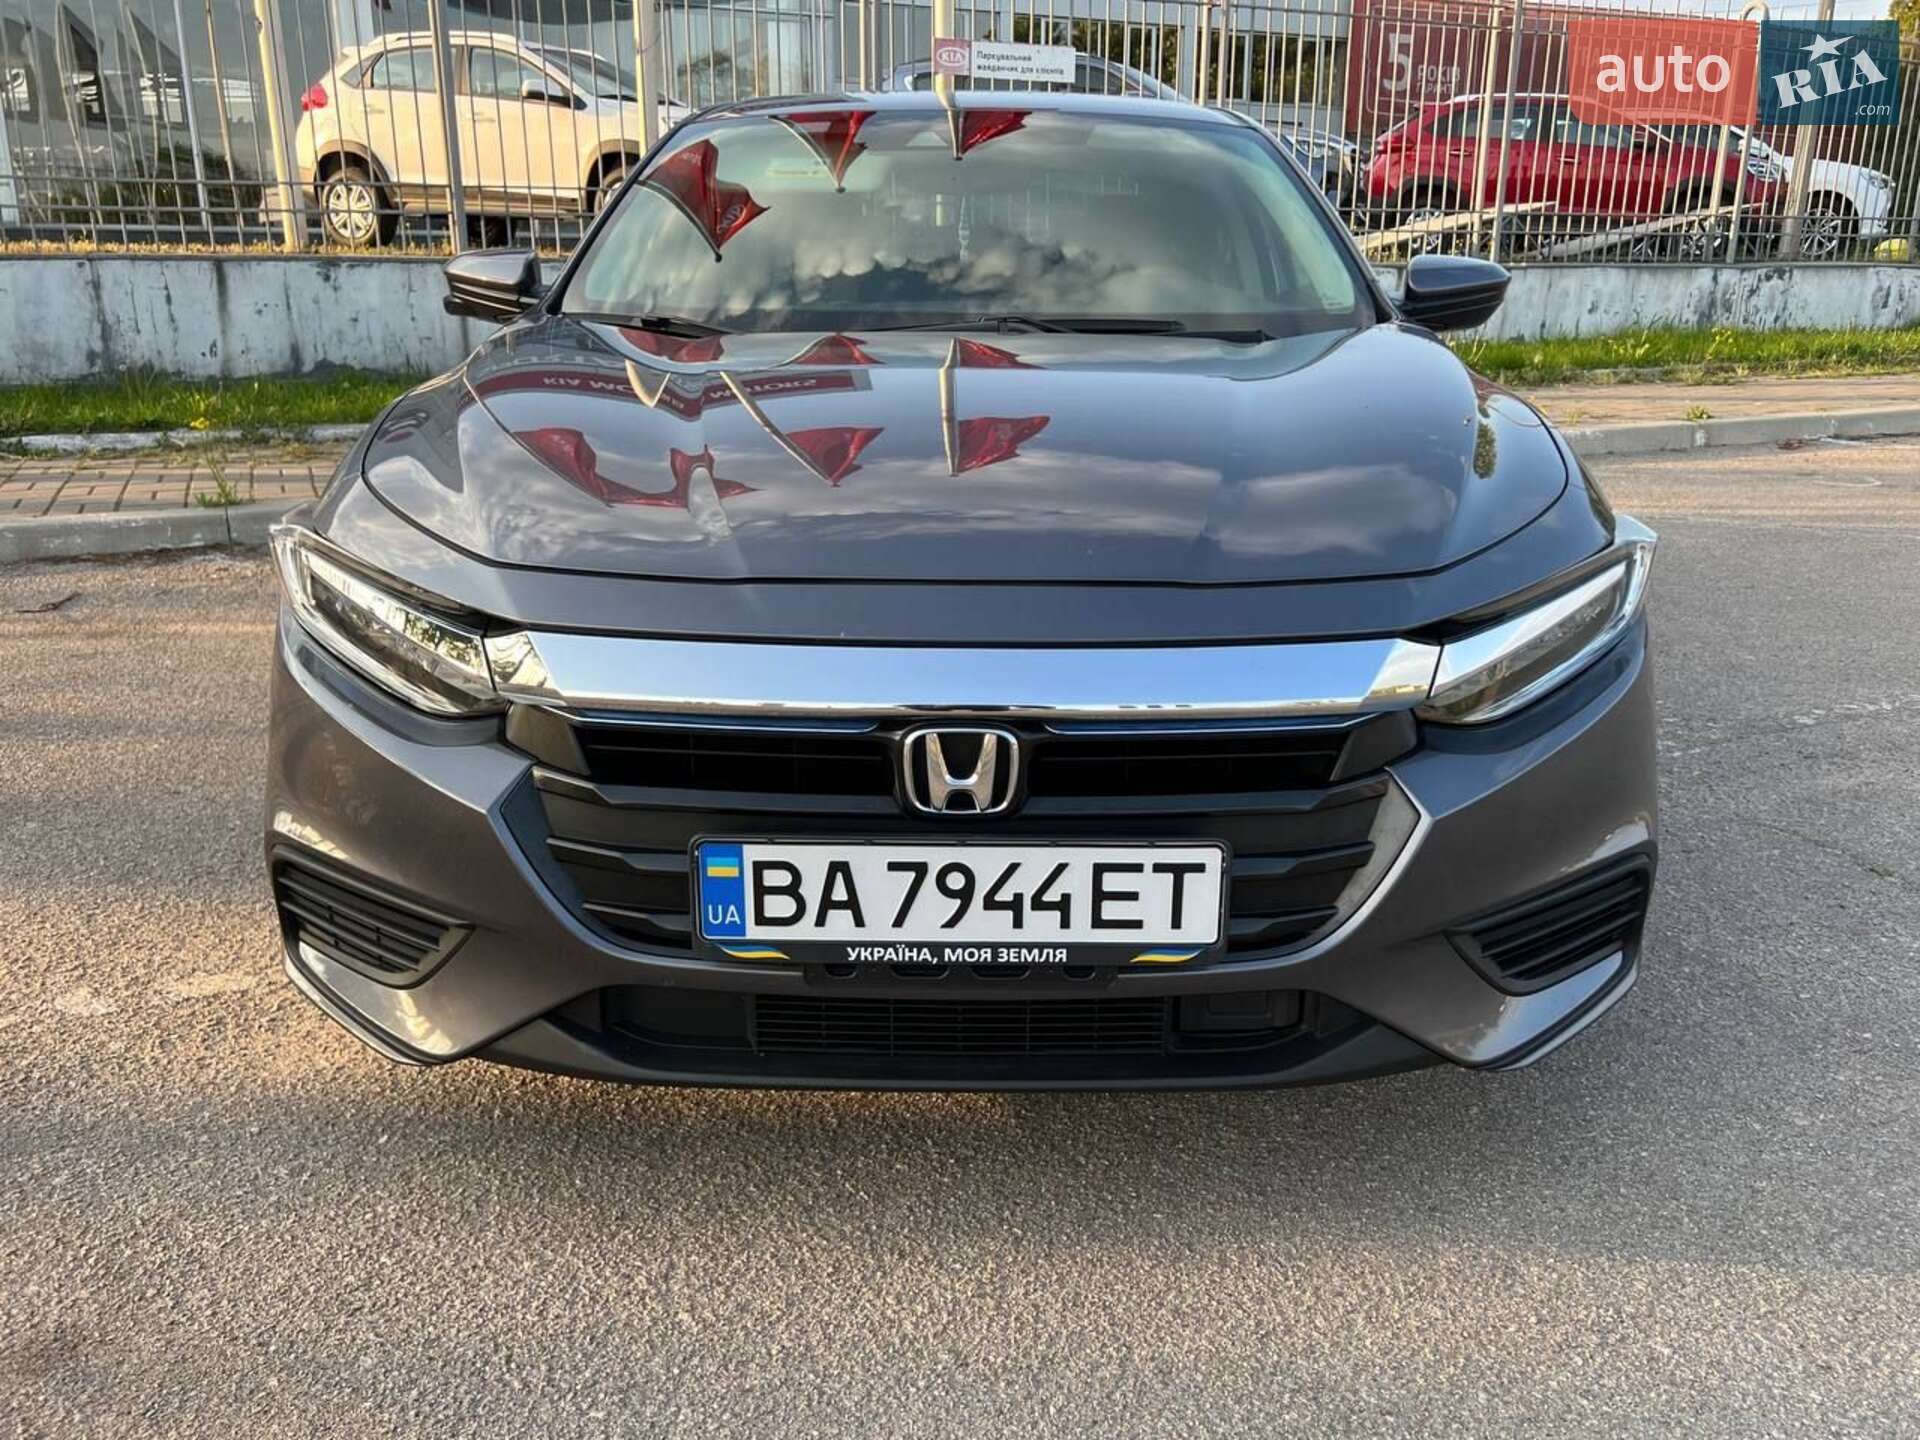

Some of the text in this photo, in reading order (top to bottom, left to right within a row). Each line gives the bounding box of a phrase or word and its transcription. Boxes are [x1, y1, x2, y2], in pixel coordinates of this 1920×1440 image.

[939, 49, 965, 65] KIA
[1382, 33, 1415, 92] 5
[751, 859, 1207, 931] BA 7944 ET
[707, 904, 741, 925] UA
[846, 945, 1068, 965] УКРАЇНА, МОЯ ЗЕМЛЯ
